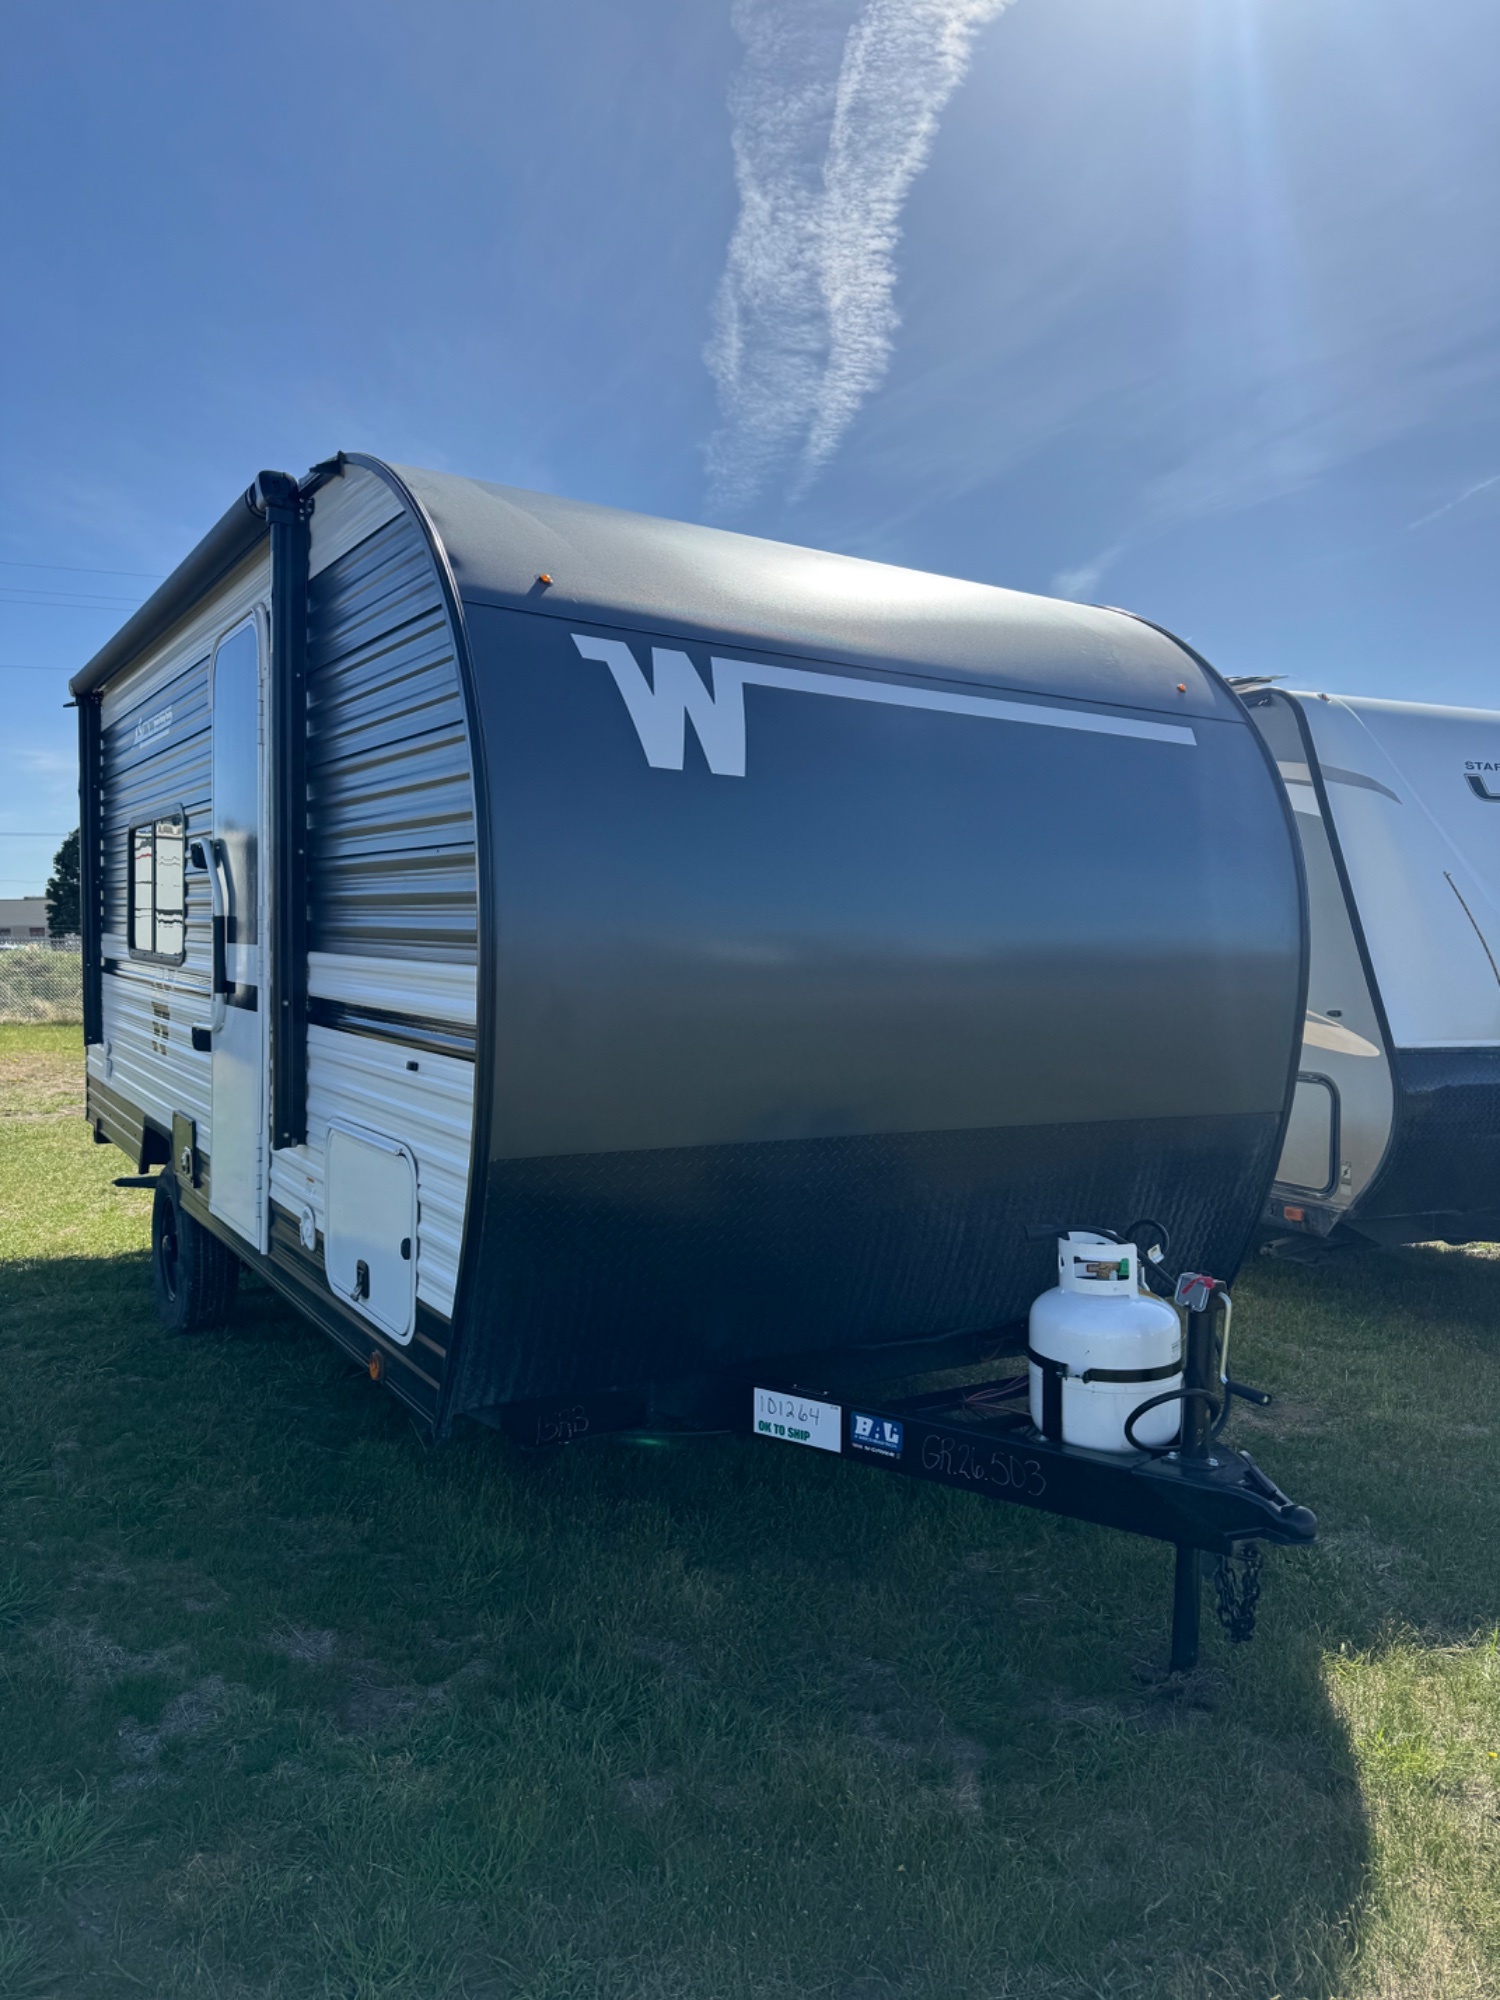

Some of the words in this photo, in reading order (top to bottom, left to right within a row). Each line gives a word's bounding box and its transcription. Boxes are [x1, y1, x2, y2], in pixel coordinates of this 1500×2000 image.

[570, 632, 748, 778] W
[759, 1394, 820, 1426] 101264
[758, 1420, 771, 1433] OK
[773, 1423, 786, 1436] TO
[787, 1427, 811, 1441] SHIP
